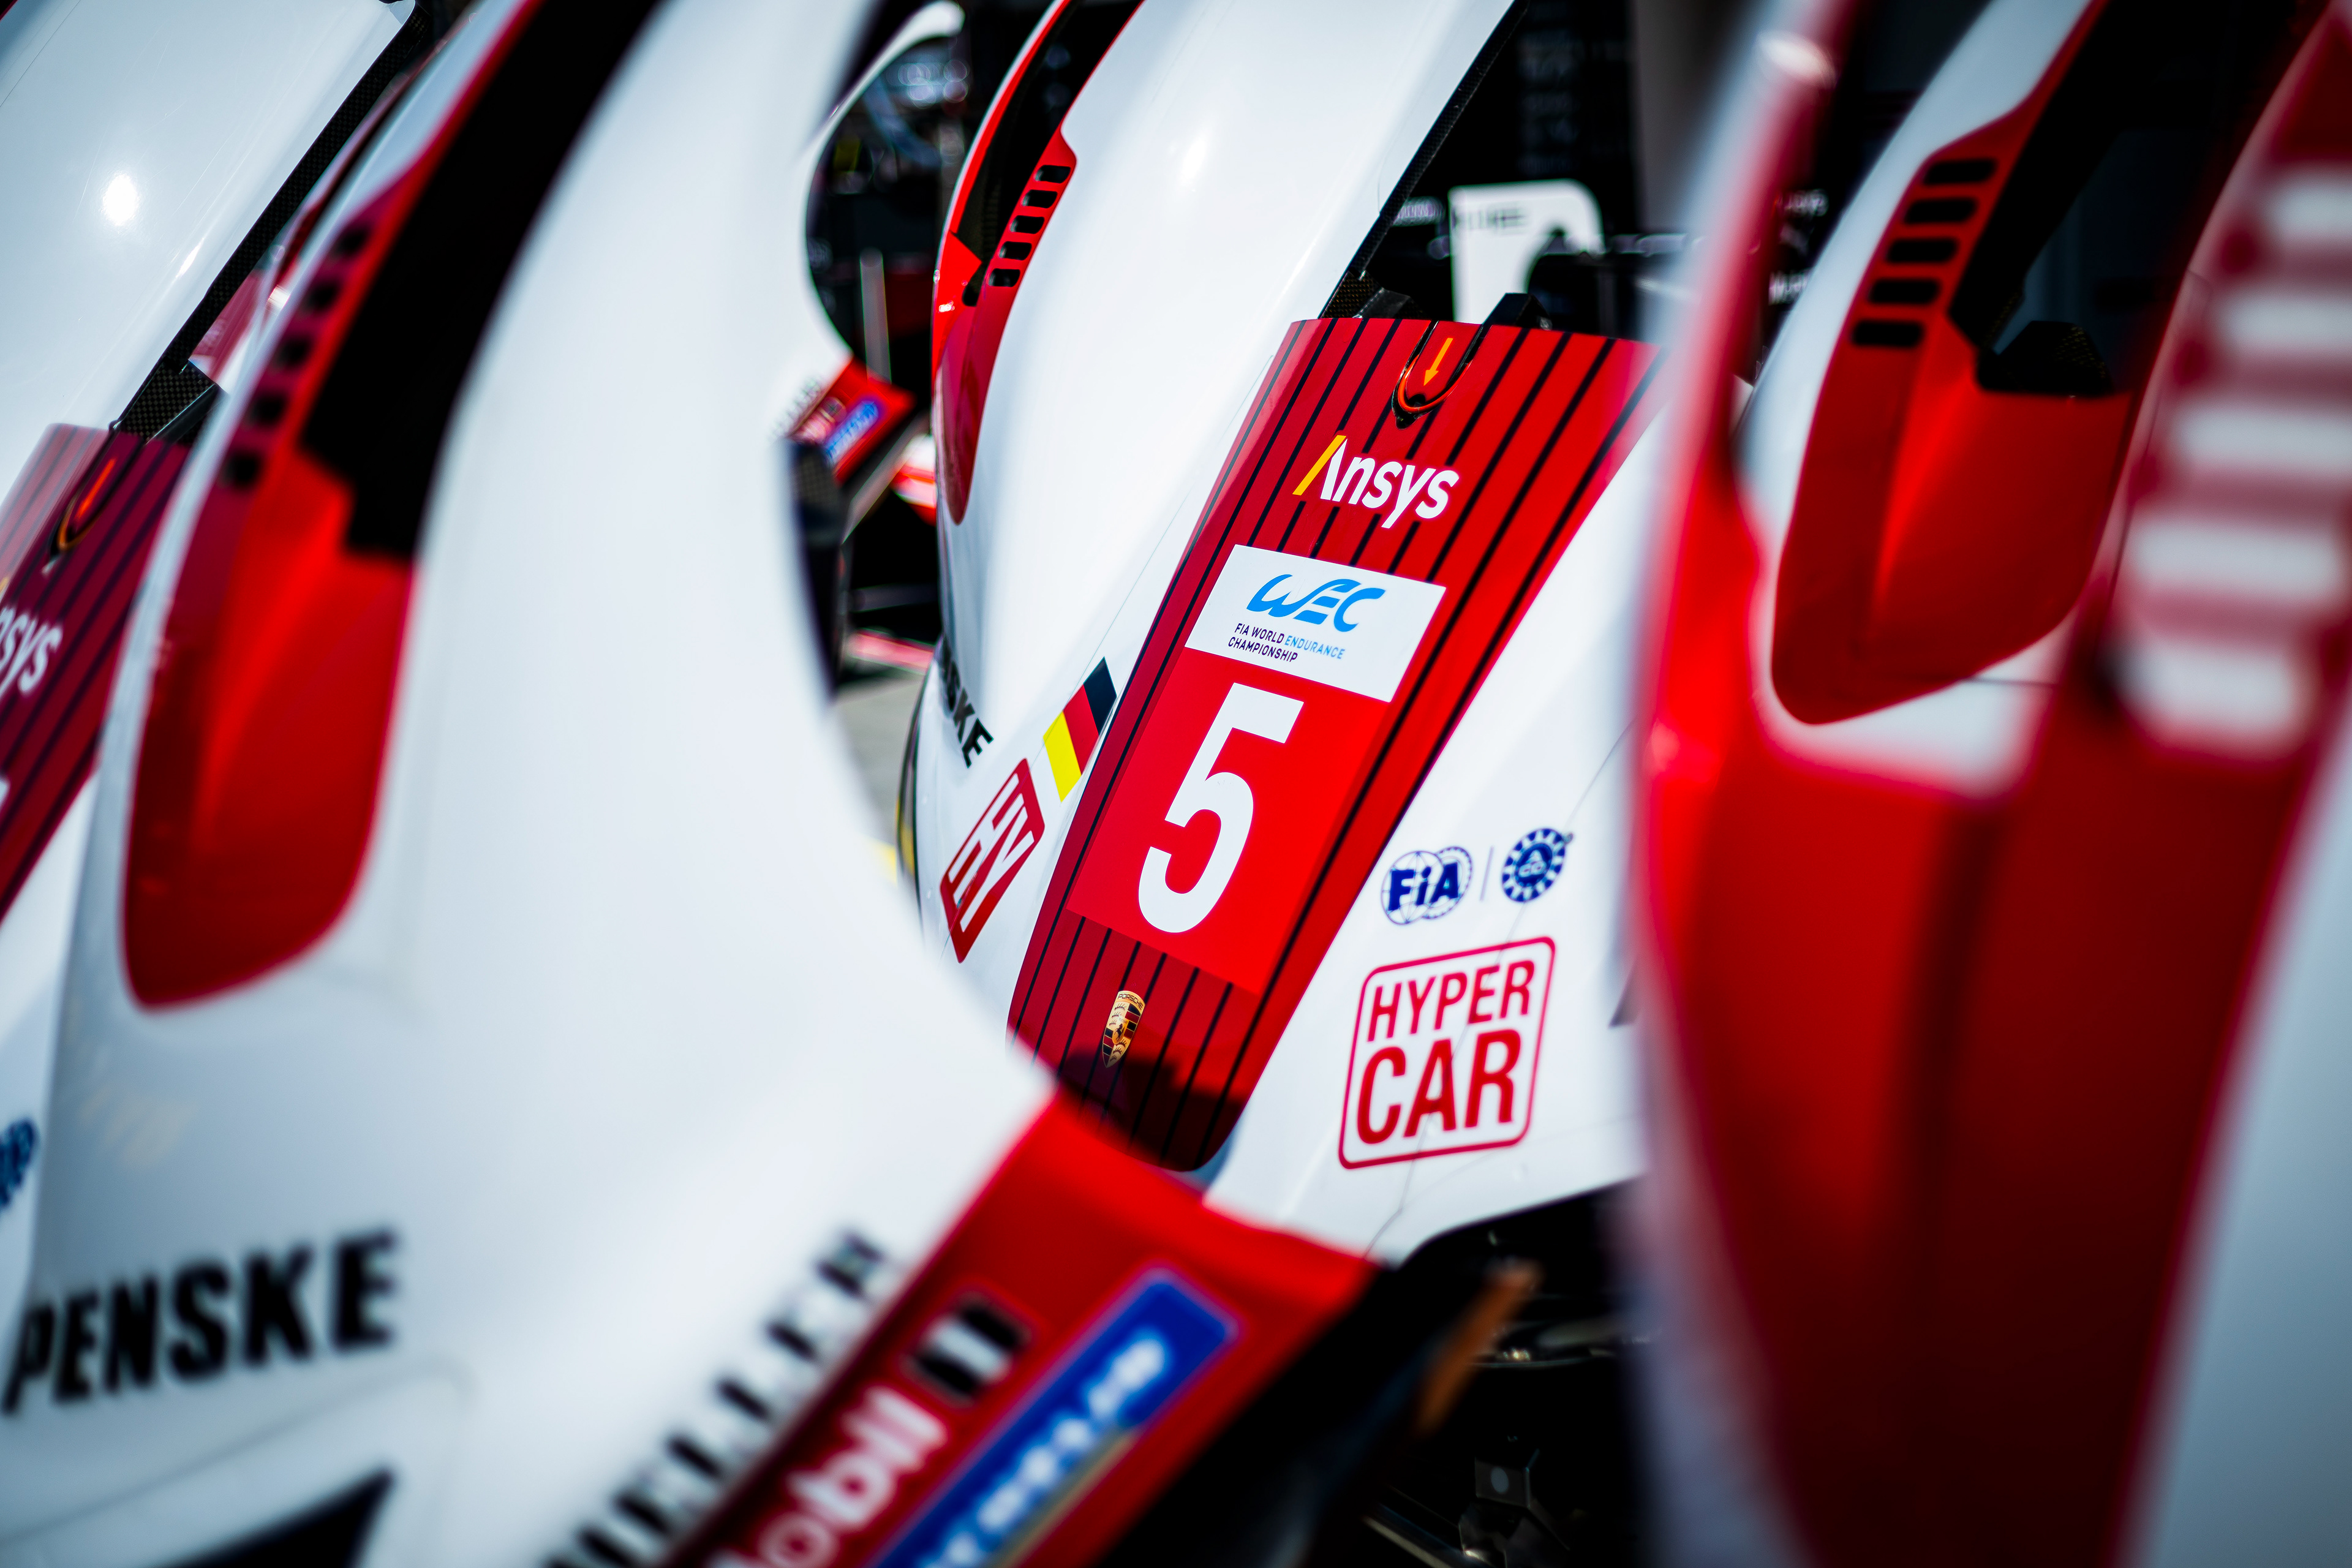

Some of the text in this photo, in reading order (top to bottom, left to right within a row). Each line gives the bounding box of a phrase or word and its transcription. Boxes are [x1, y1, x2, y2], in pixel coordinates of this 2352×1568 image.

[1292, 435, 1460, 529] Ansys
[1235, 623, 1346, 659] FIA WORLD ENDURANCE
[1246, 574, 1386, 632] WEC
[0, 605, 62, 696] sys
[1228, 636, 1298, 662] CHAMPIONSHIP
[1138, 682, 1304, 933] 5
[1118, 993, 1144, 1010] PORSCHE
[1367, 960, 1536, 1042] HYPER
[1357, 1029, 1521, 1144] CAR
[2, 1228, 397, 1416] PENSKE
